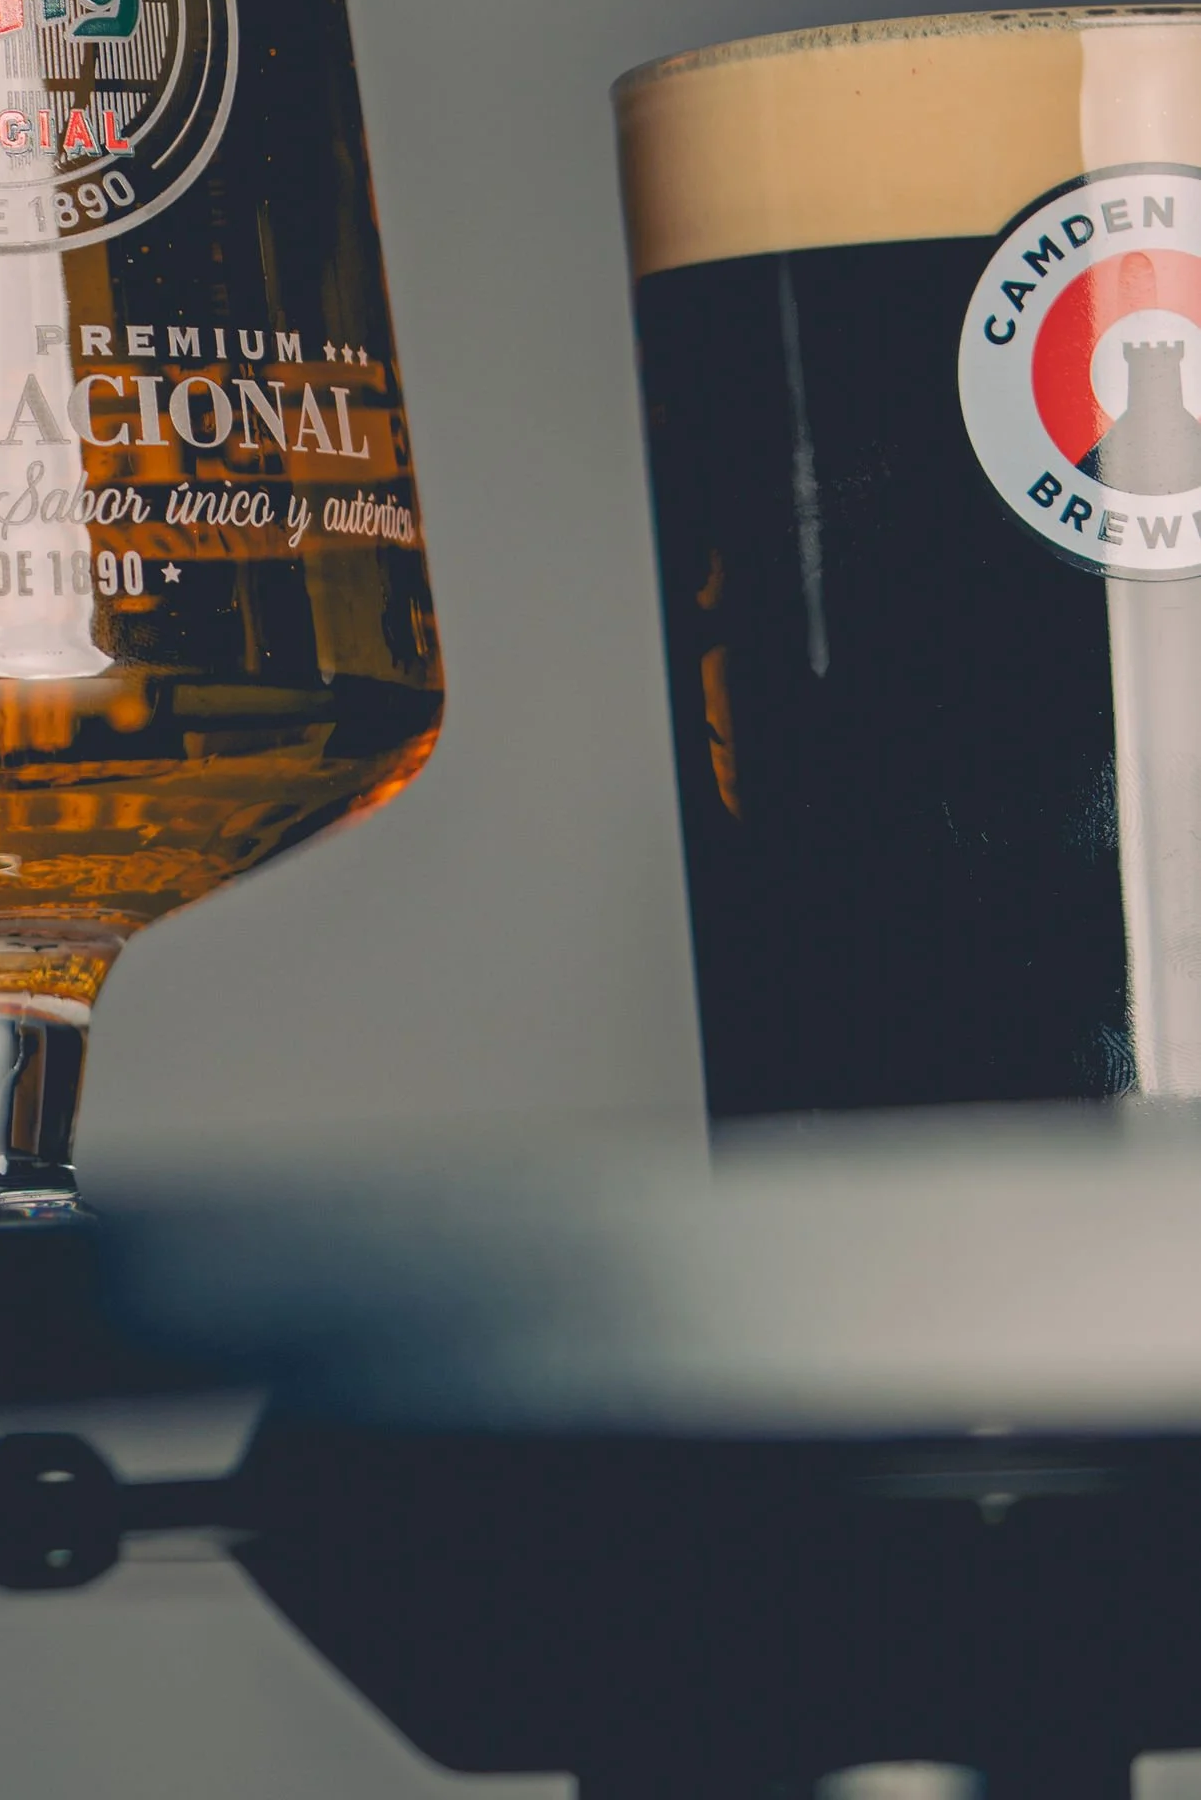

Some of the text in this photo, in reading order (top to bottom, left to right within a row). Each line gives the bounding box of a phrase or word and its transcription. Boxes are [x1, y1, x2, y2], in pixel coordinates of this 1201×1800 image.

[29, 169, 136, 233] 1890
[983, 195, 1175, 346] CAMDEN
[35, 324, 304, 364] PREMIUM
[165, 480, 275, 528] único
[286, 492, 312, 548] y
[1027, 471, 1201, 551] BREW
[47, 550, 144, 597] 1890
